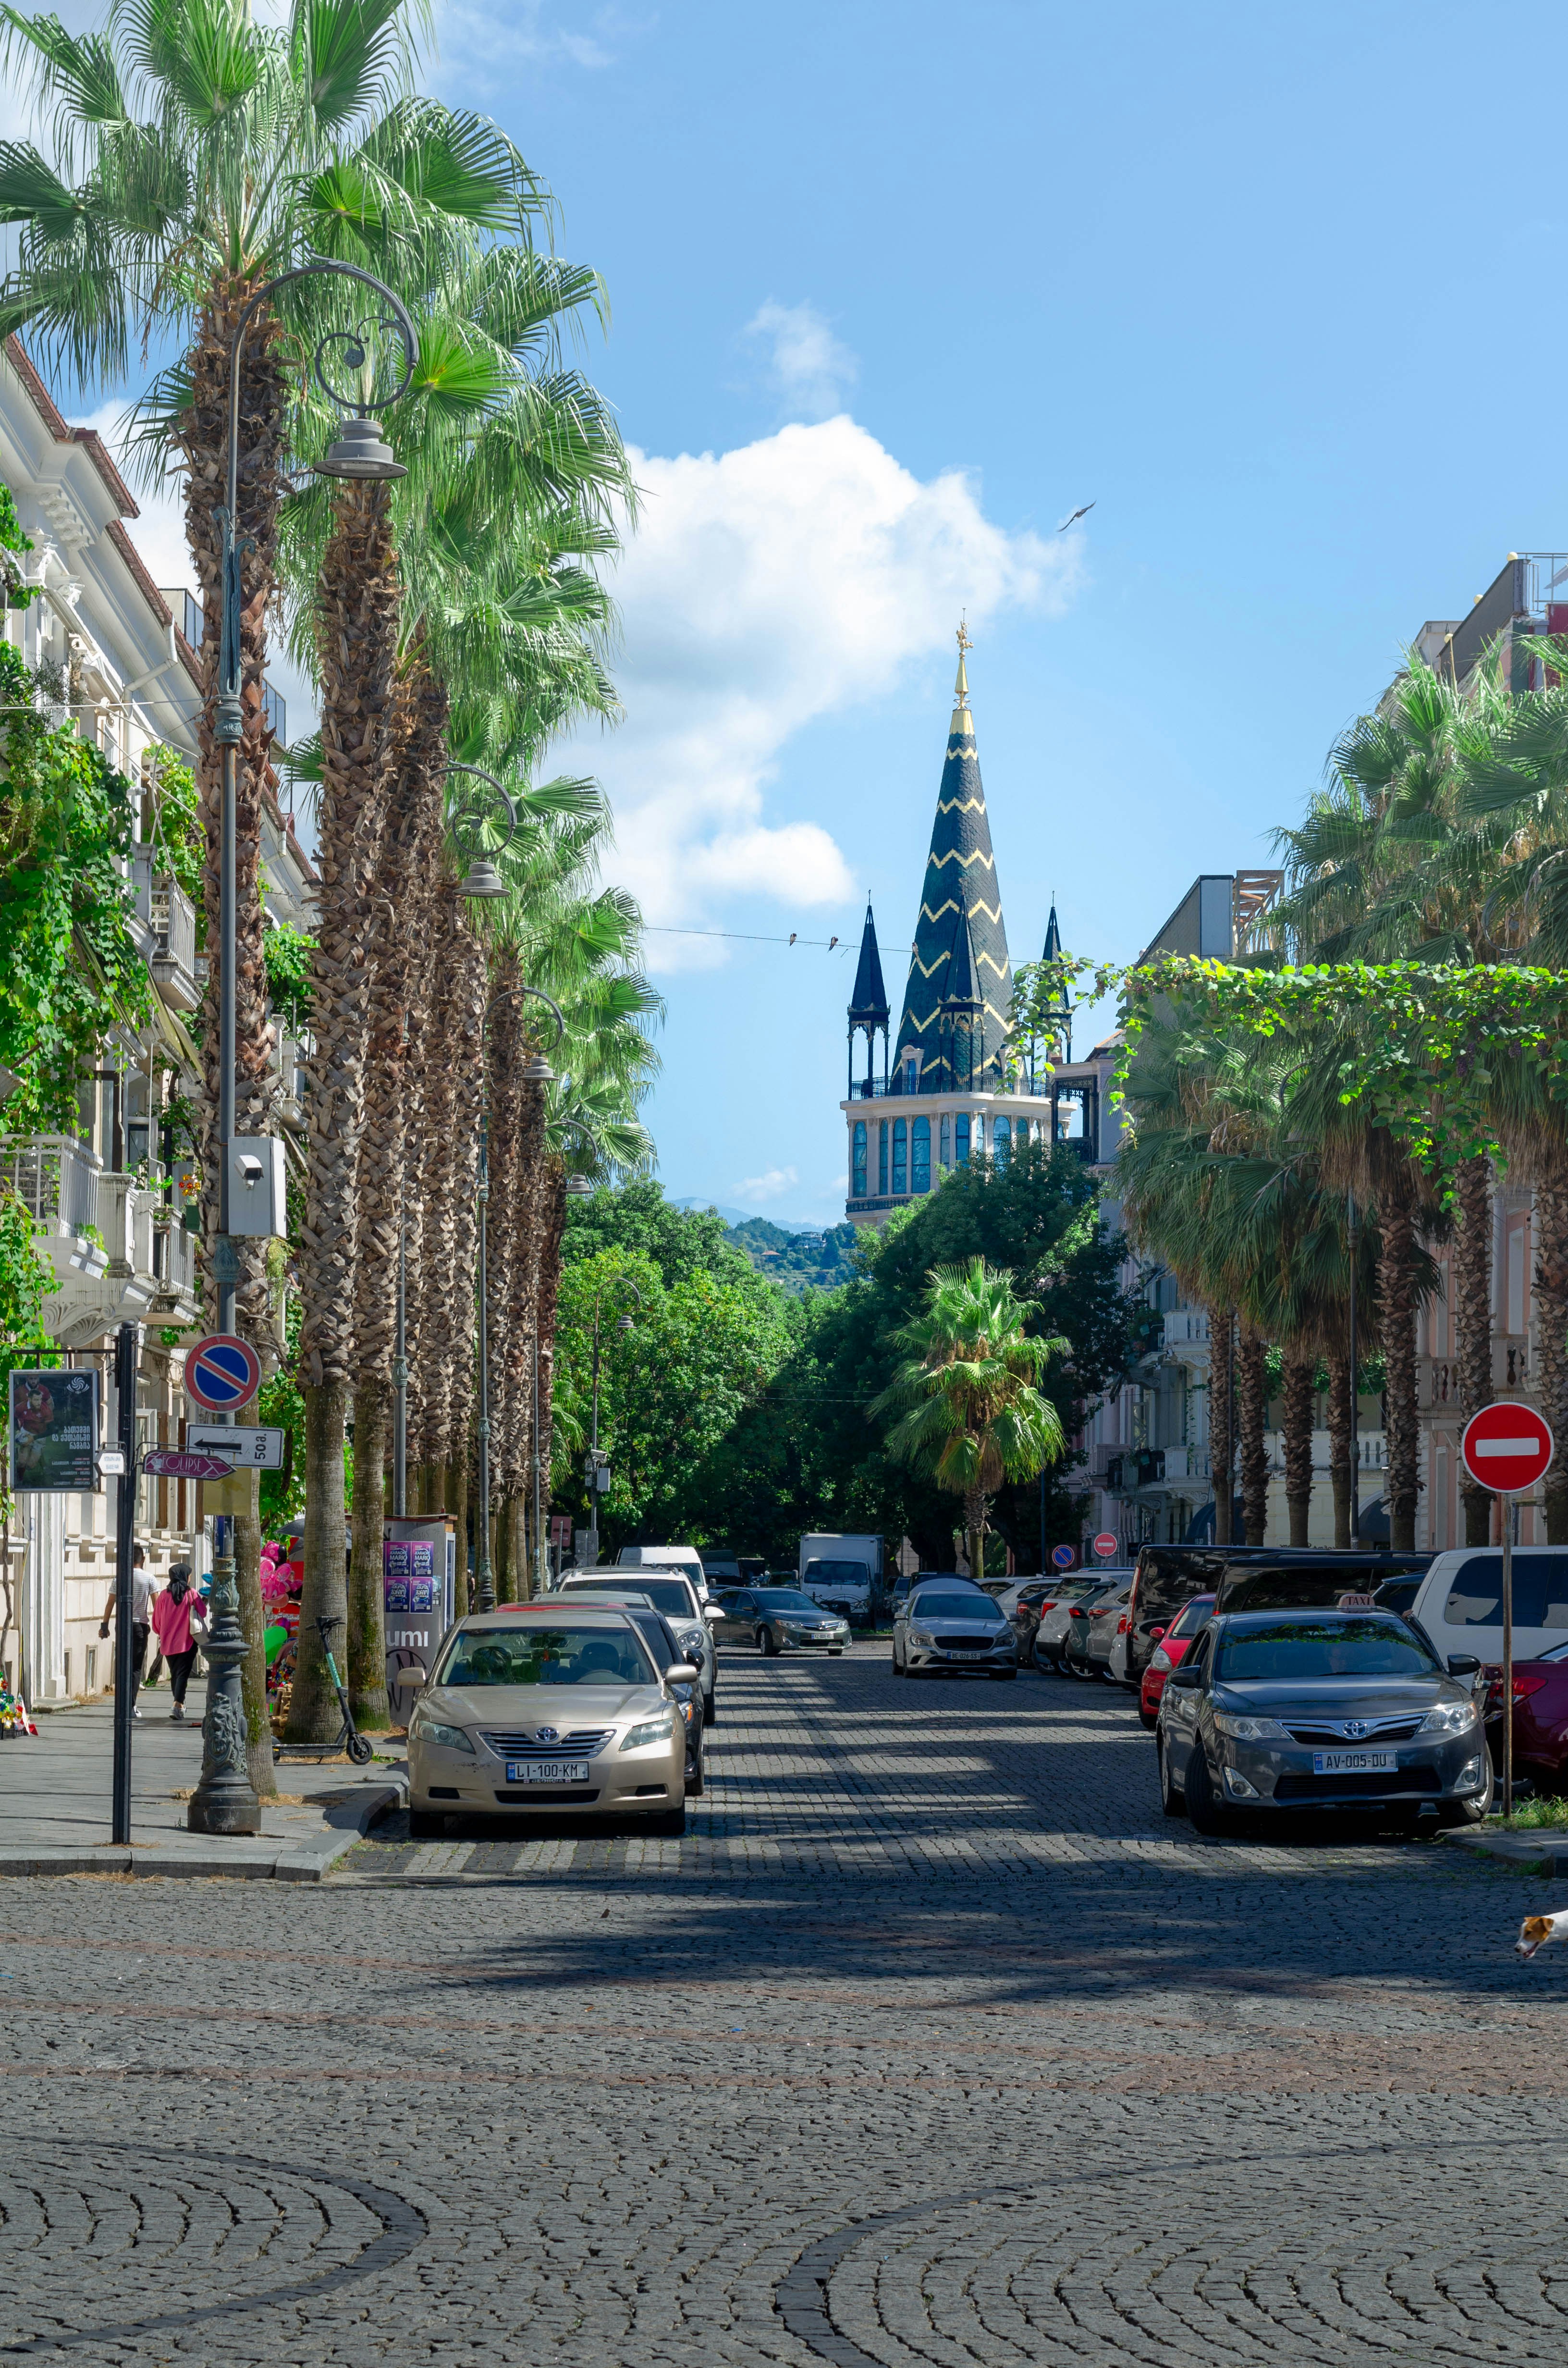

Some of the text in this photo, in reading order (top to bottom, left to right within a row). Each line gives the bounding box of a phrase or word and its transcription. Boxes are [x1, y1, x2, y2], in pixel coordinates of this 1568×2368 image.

[162, 1455, 202, 1472] ECLIPSE
[1346, 1596, 1370, 1605] TAXI
[1326, 1754, 1387, 1768] AV-005-DU
[517, 1764, 578, 1777] LI-100-KM
